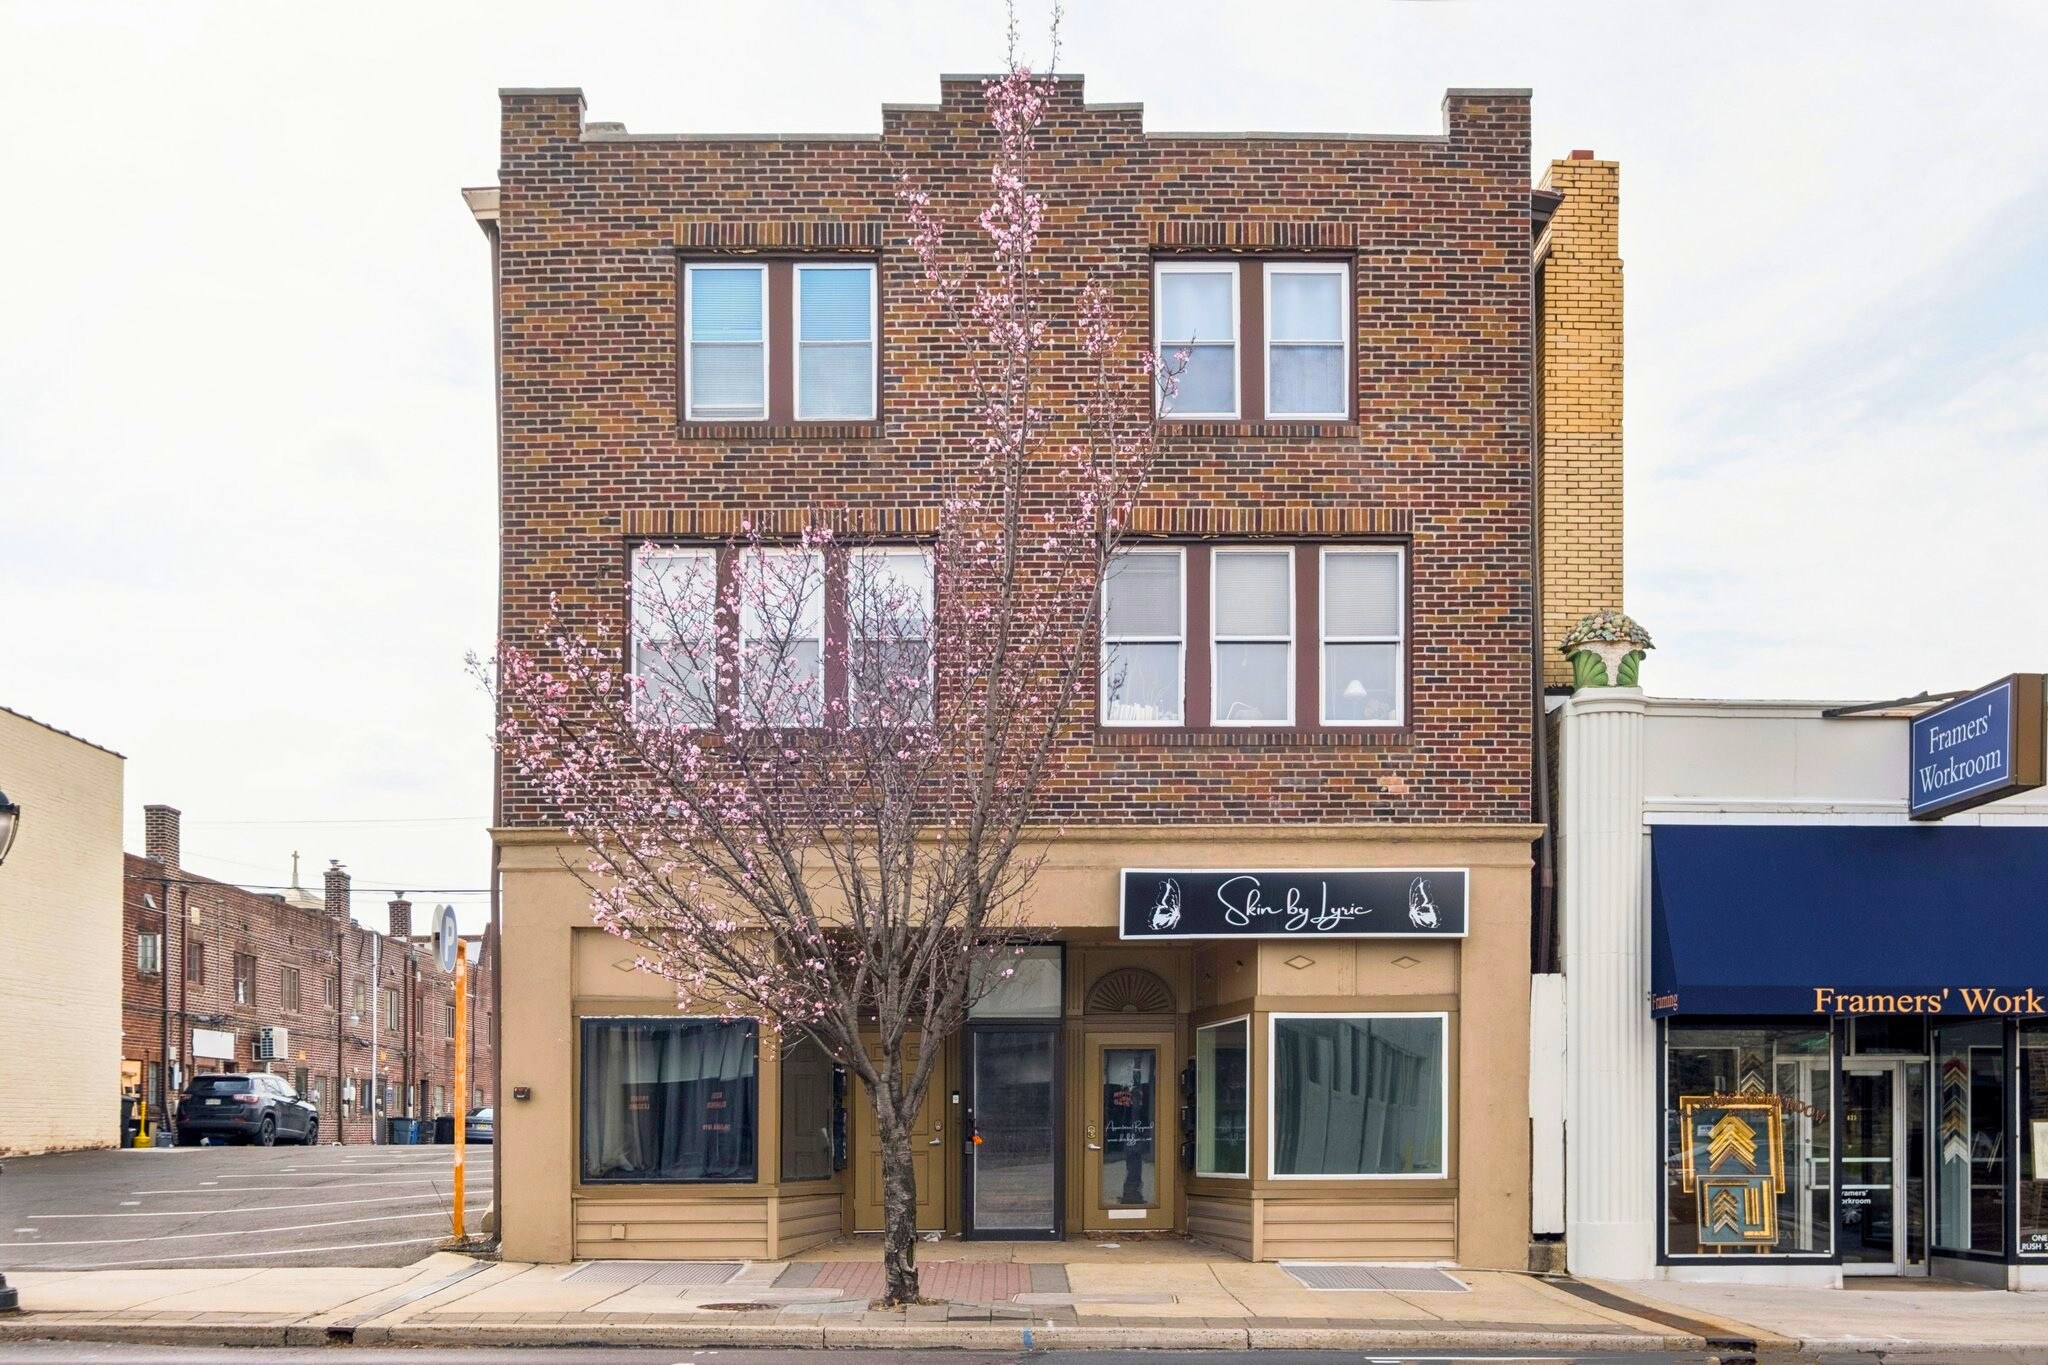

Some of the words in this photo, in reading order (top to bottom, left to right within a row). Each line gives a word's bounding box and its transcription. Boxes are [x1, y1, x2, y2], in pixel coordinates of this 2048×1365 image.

[1929, 704, 1992, 754] Framers'
[1919, 749, 2002, 793] Workroom
[1217, 875, 1283, 926] Skin
[1285, 887, 1309, 931] by
[1310, 881, 1373, 931] Lyric
[1813, 987, 1949, 1013] Framers'
[1958, 987, 2046, 1013] Work
[2021, 1242, 2042, 1250] RUSH
[2031, 1234, 2048, 1242] ONE
